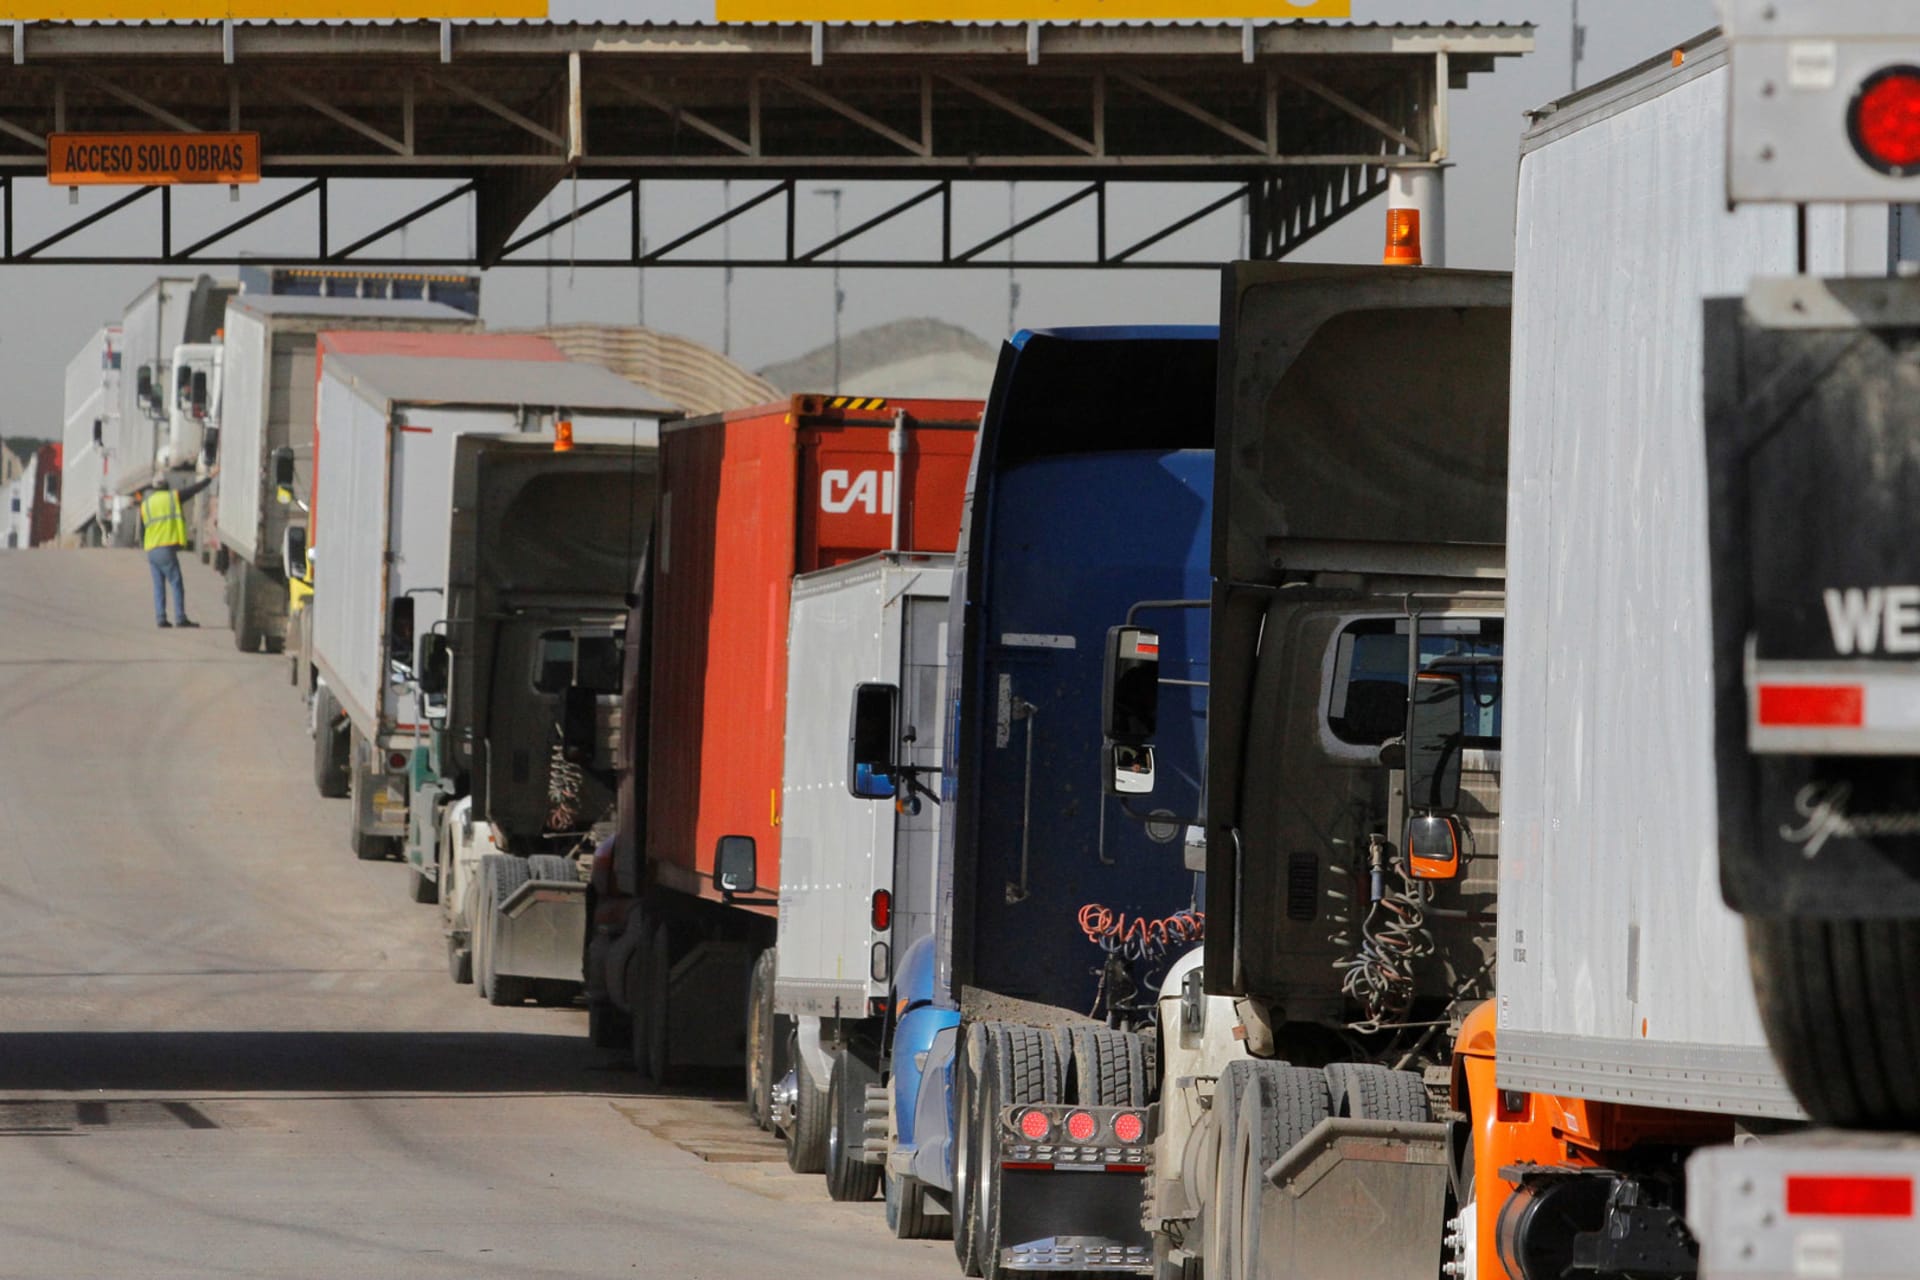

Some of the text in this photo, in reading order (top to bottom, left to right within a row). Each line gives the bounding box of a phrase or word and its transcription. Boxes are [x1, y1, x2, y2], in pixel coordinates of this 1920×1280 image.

[66, 144, 243, 172] ACCESO SOLO OBRAS
[821, 469, 893, 514] CAI
